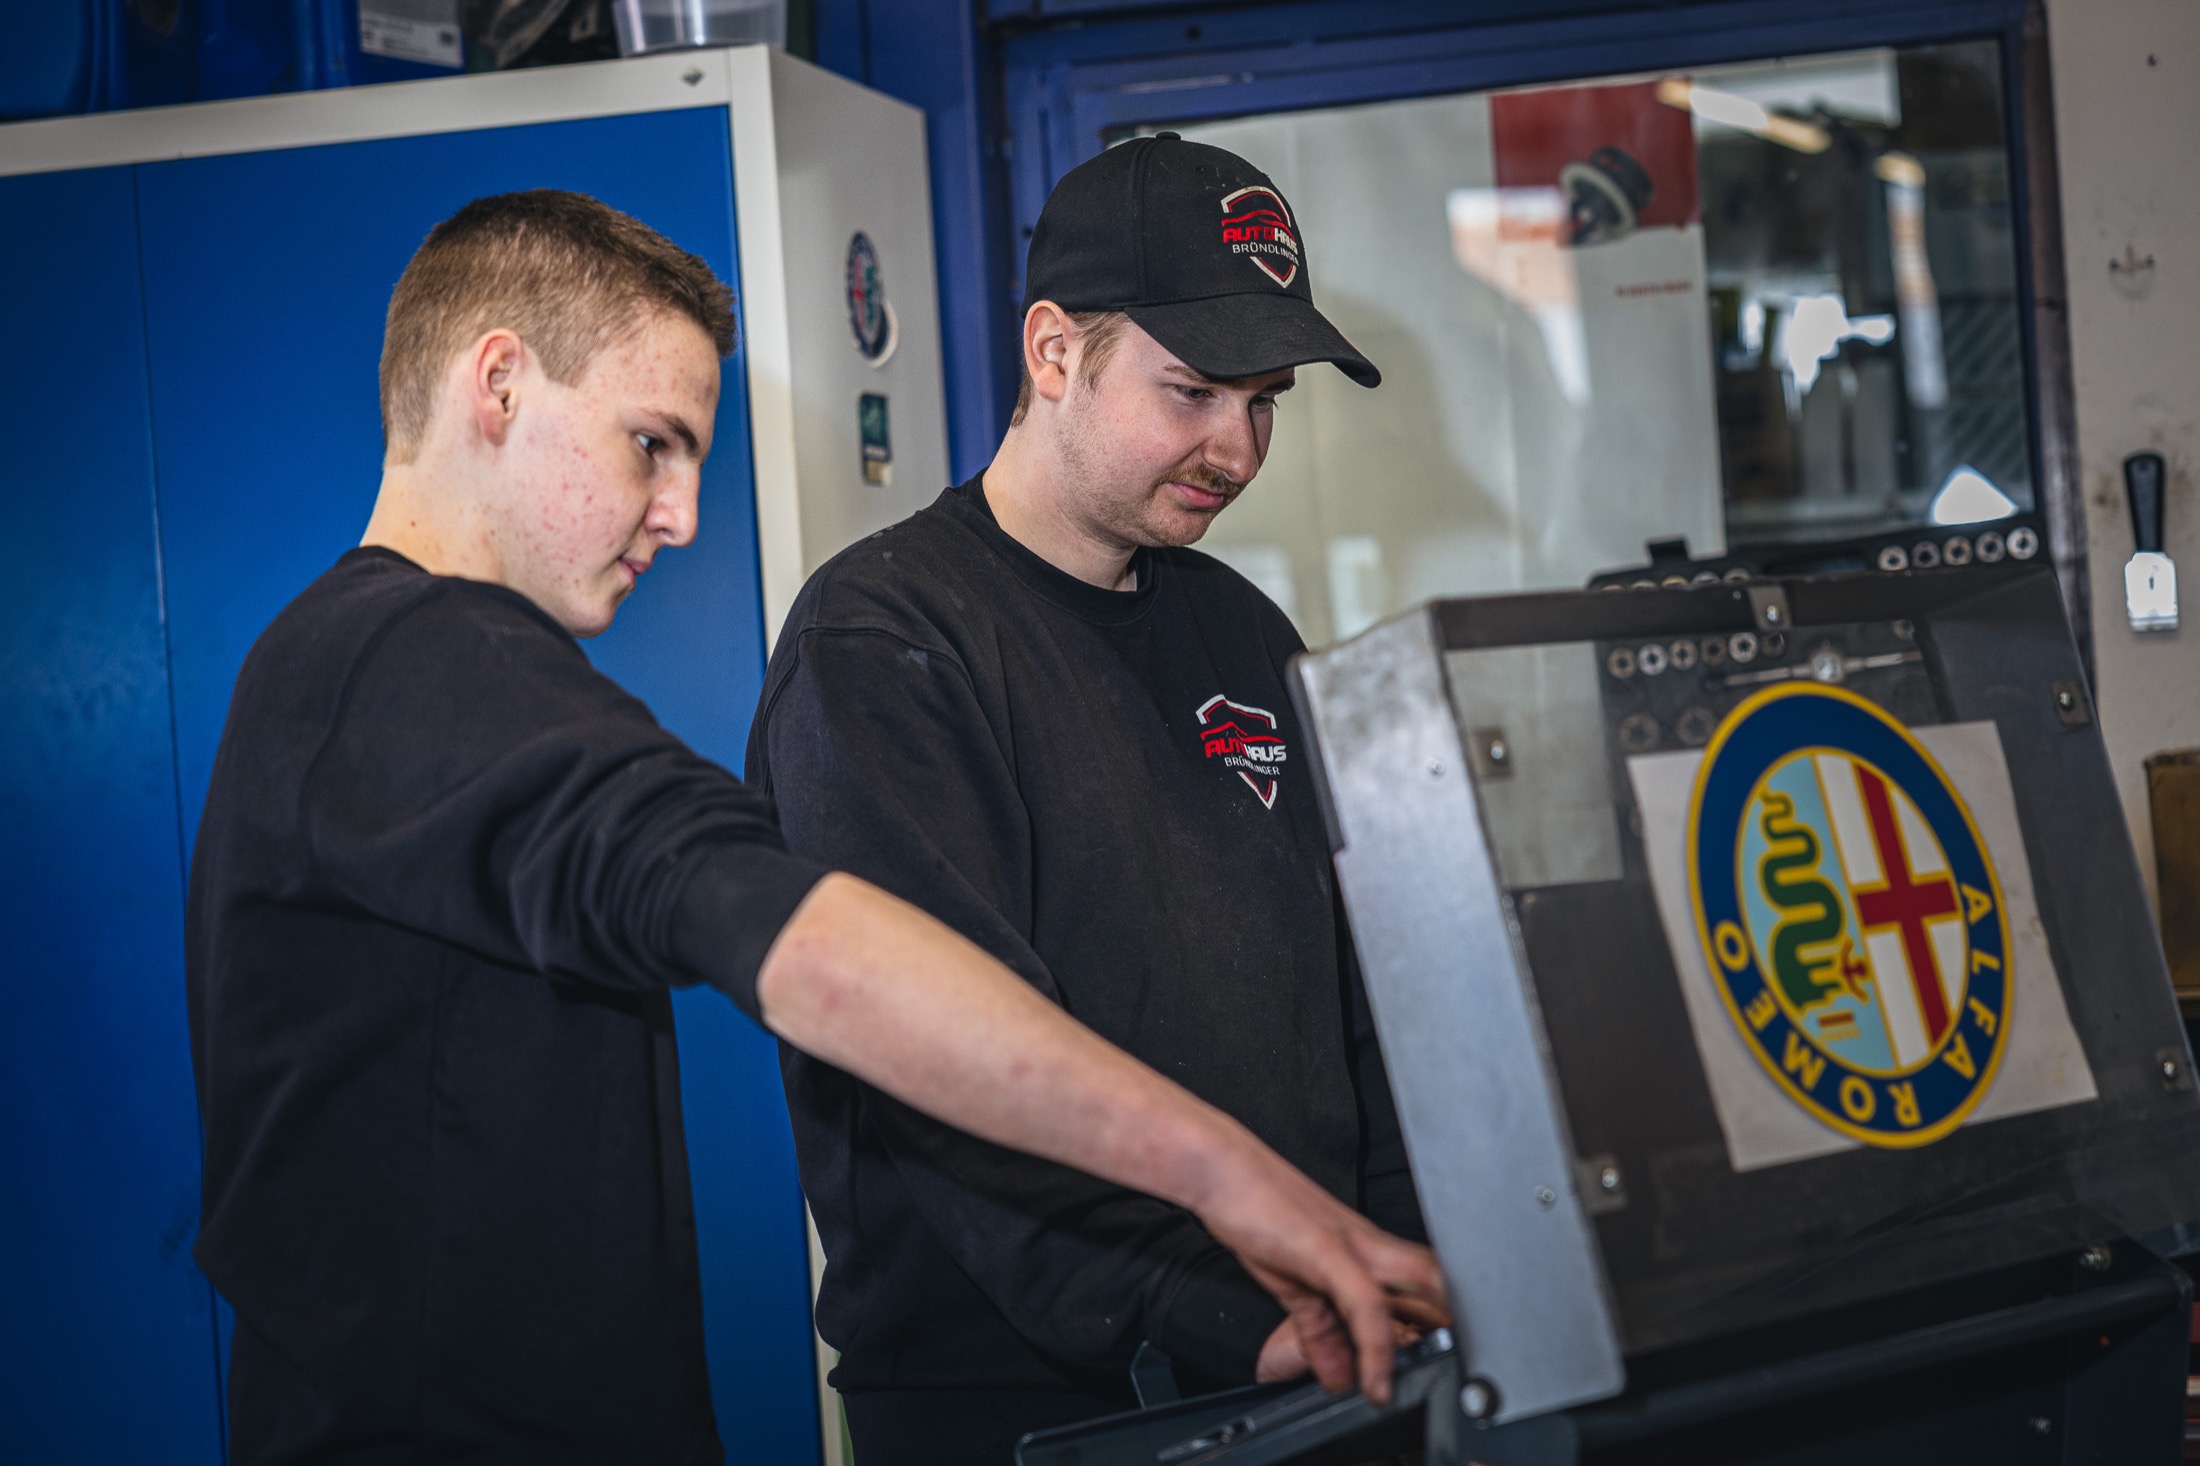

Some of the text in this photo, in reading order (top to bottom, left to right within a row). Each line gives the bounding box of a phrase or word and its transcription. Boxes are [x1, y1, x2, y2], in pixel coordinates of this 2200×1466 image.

[1223, 226, 1298, 255] AUTOHAUS
[1714, 883, 2001, 1127] ALFA ROMEO
